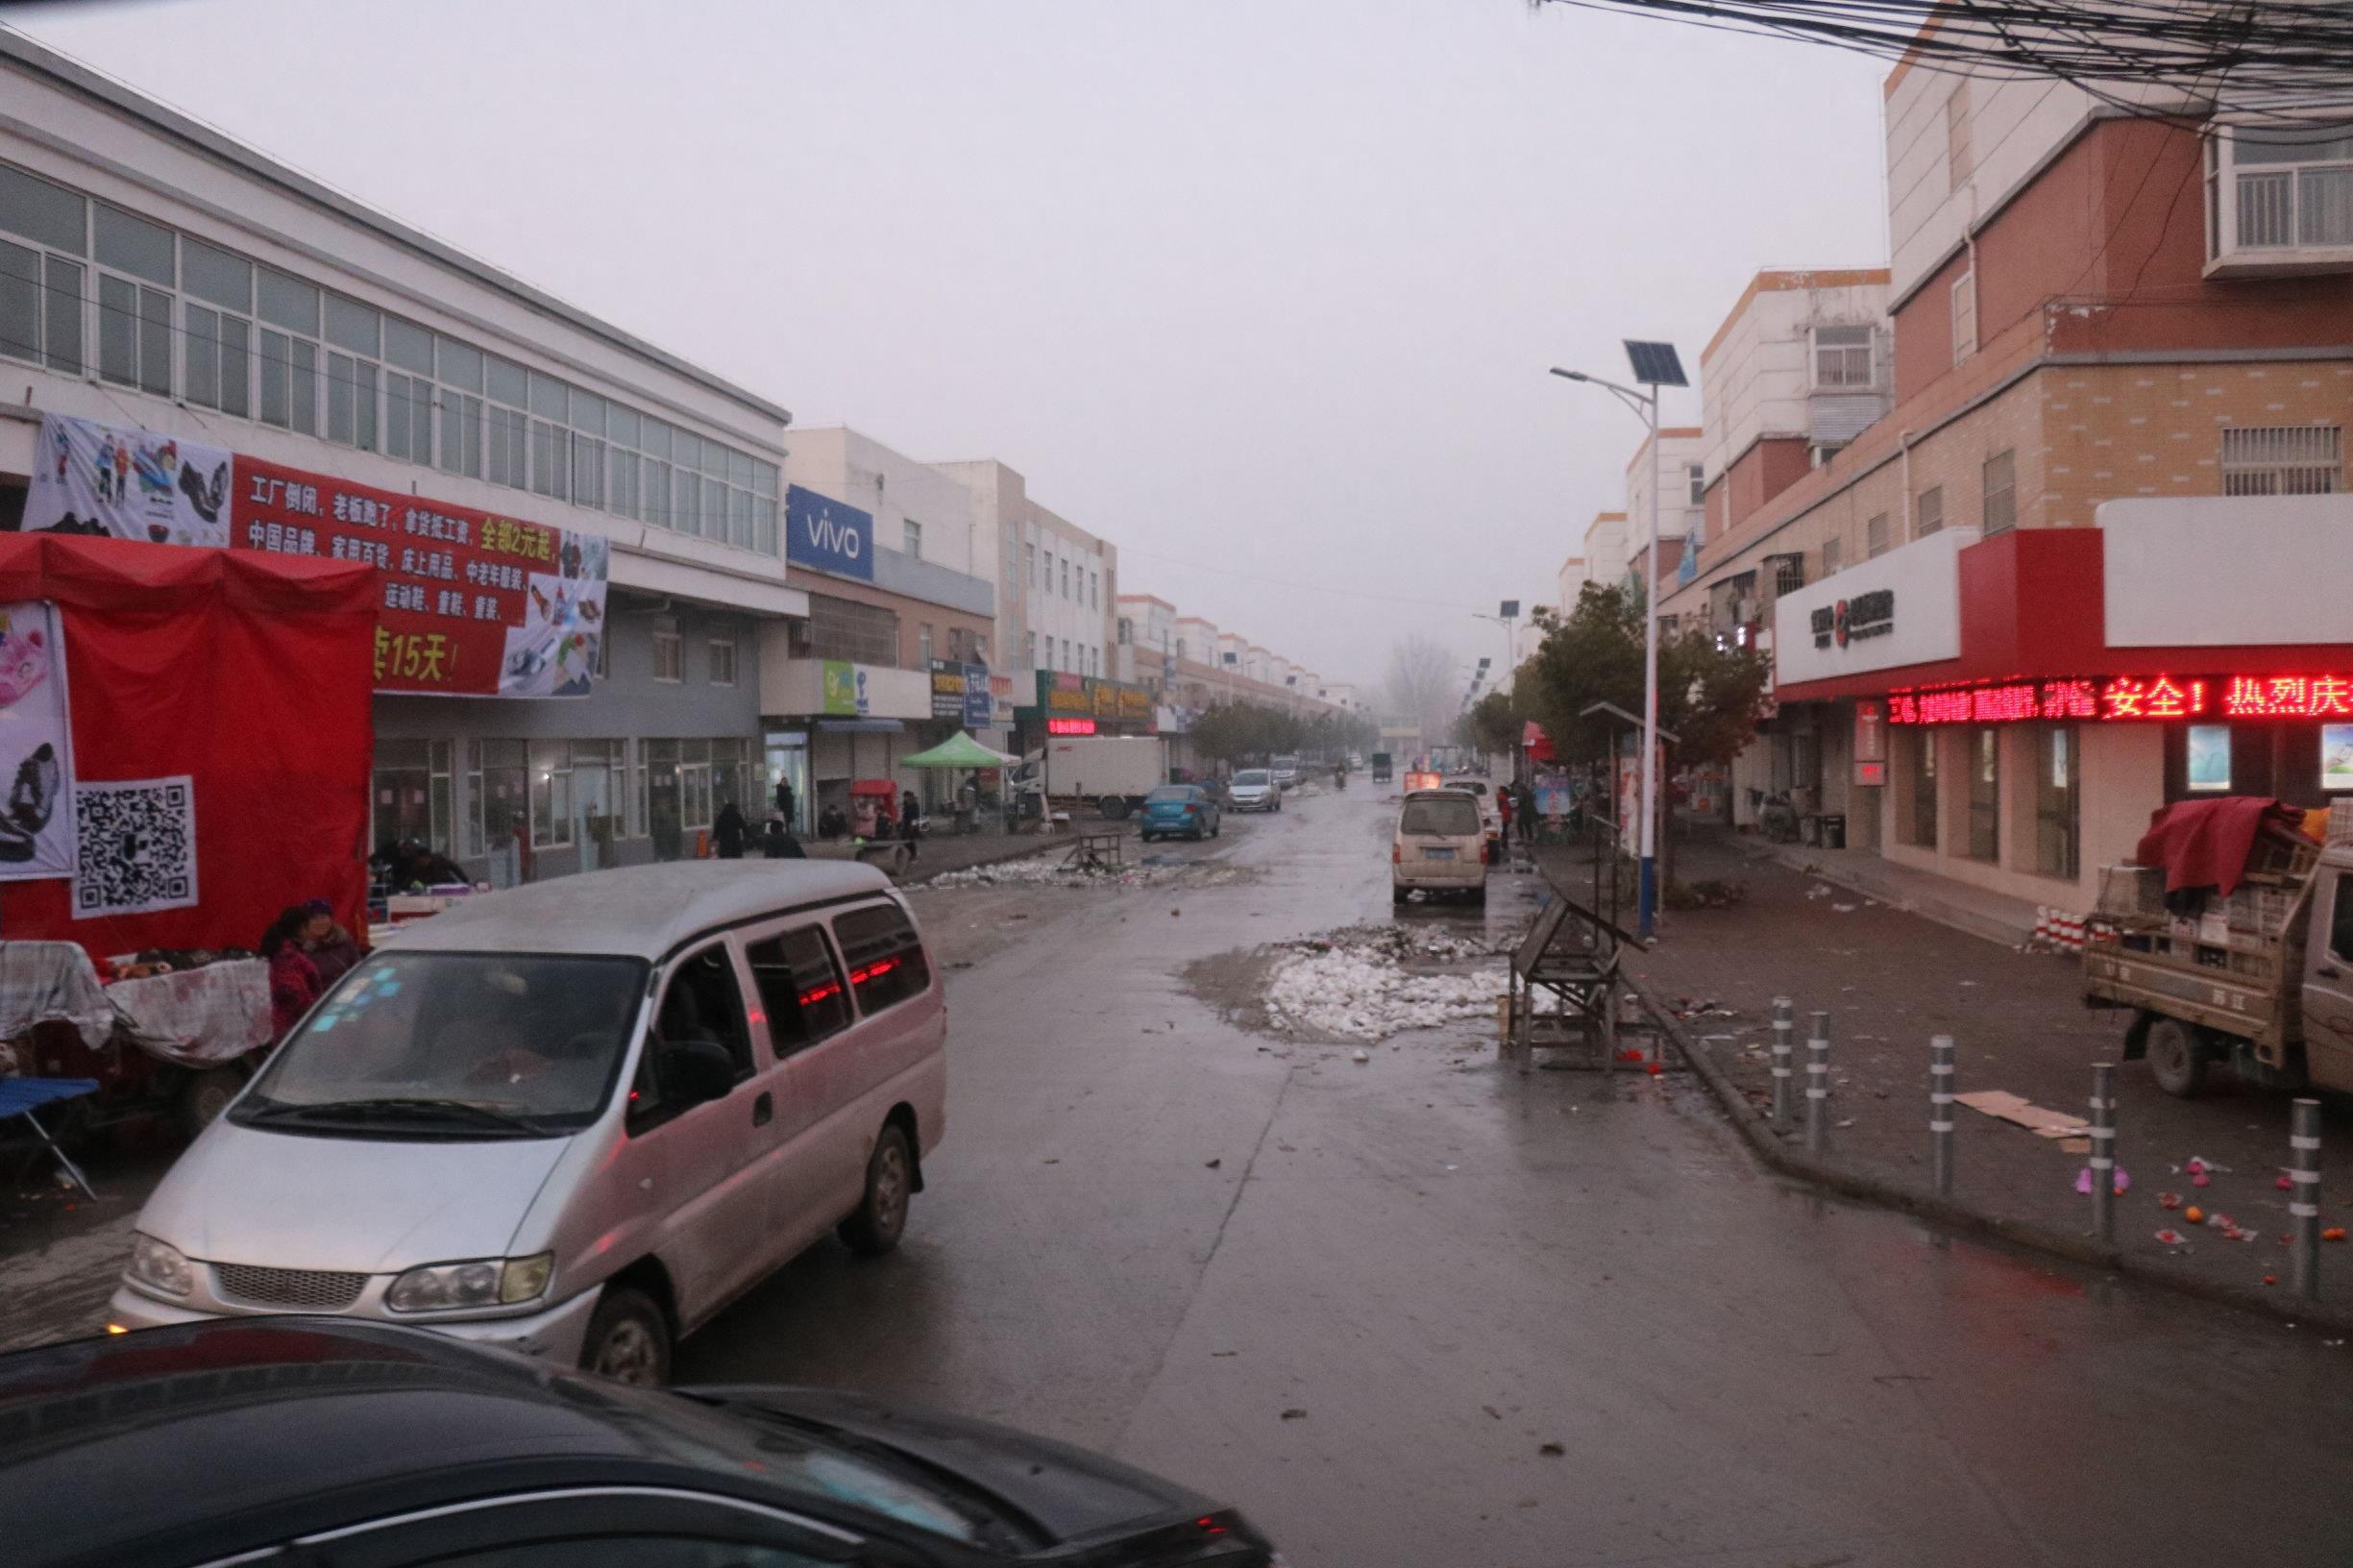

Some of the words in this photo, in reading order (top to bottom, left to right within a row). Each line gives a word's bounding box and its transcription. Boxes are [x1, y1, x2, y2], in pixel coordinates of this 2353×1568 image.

[807, 508, 860, 559] vivo
[2225, 674, 2353, 716] 热烈庆
